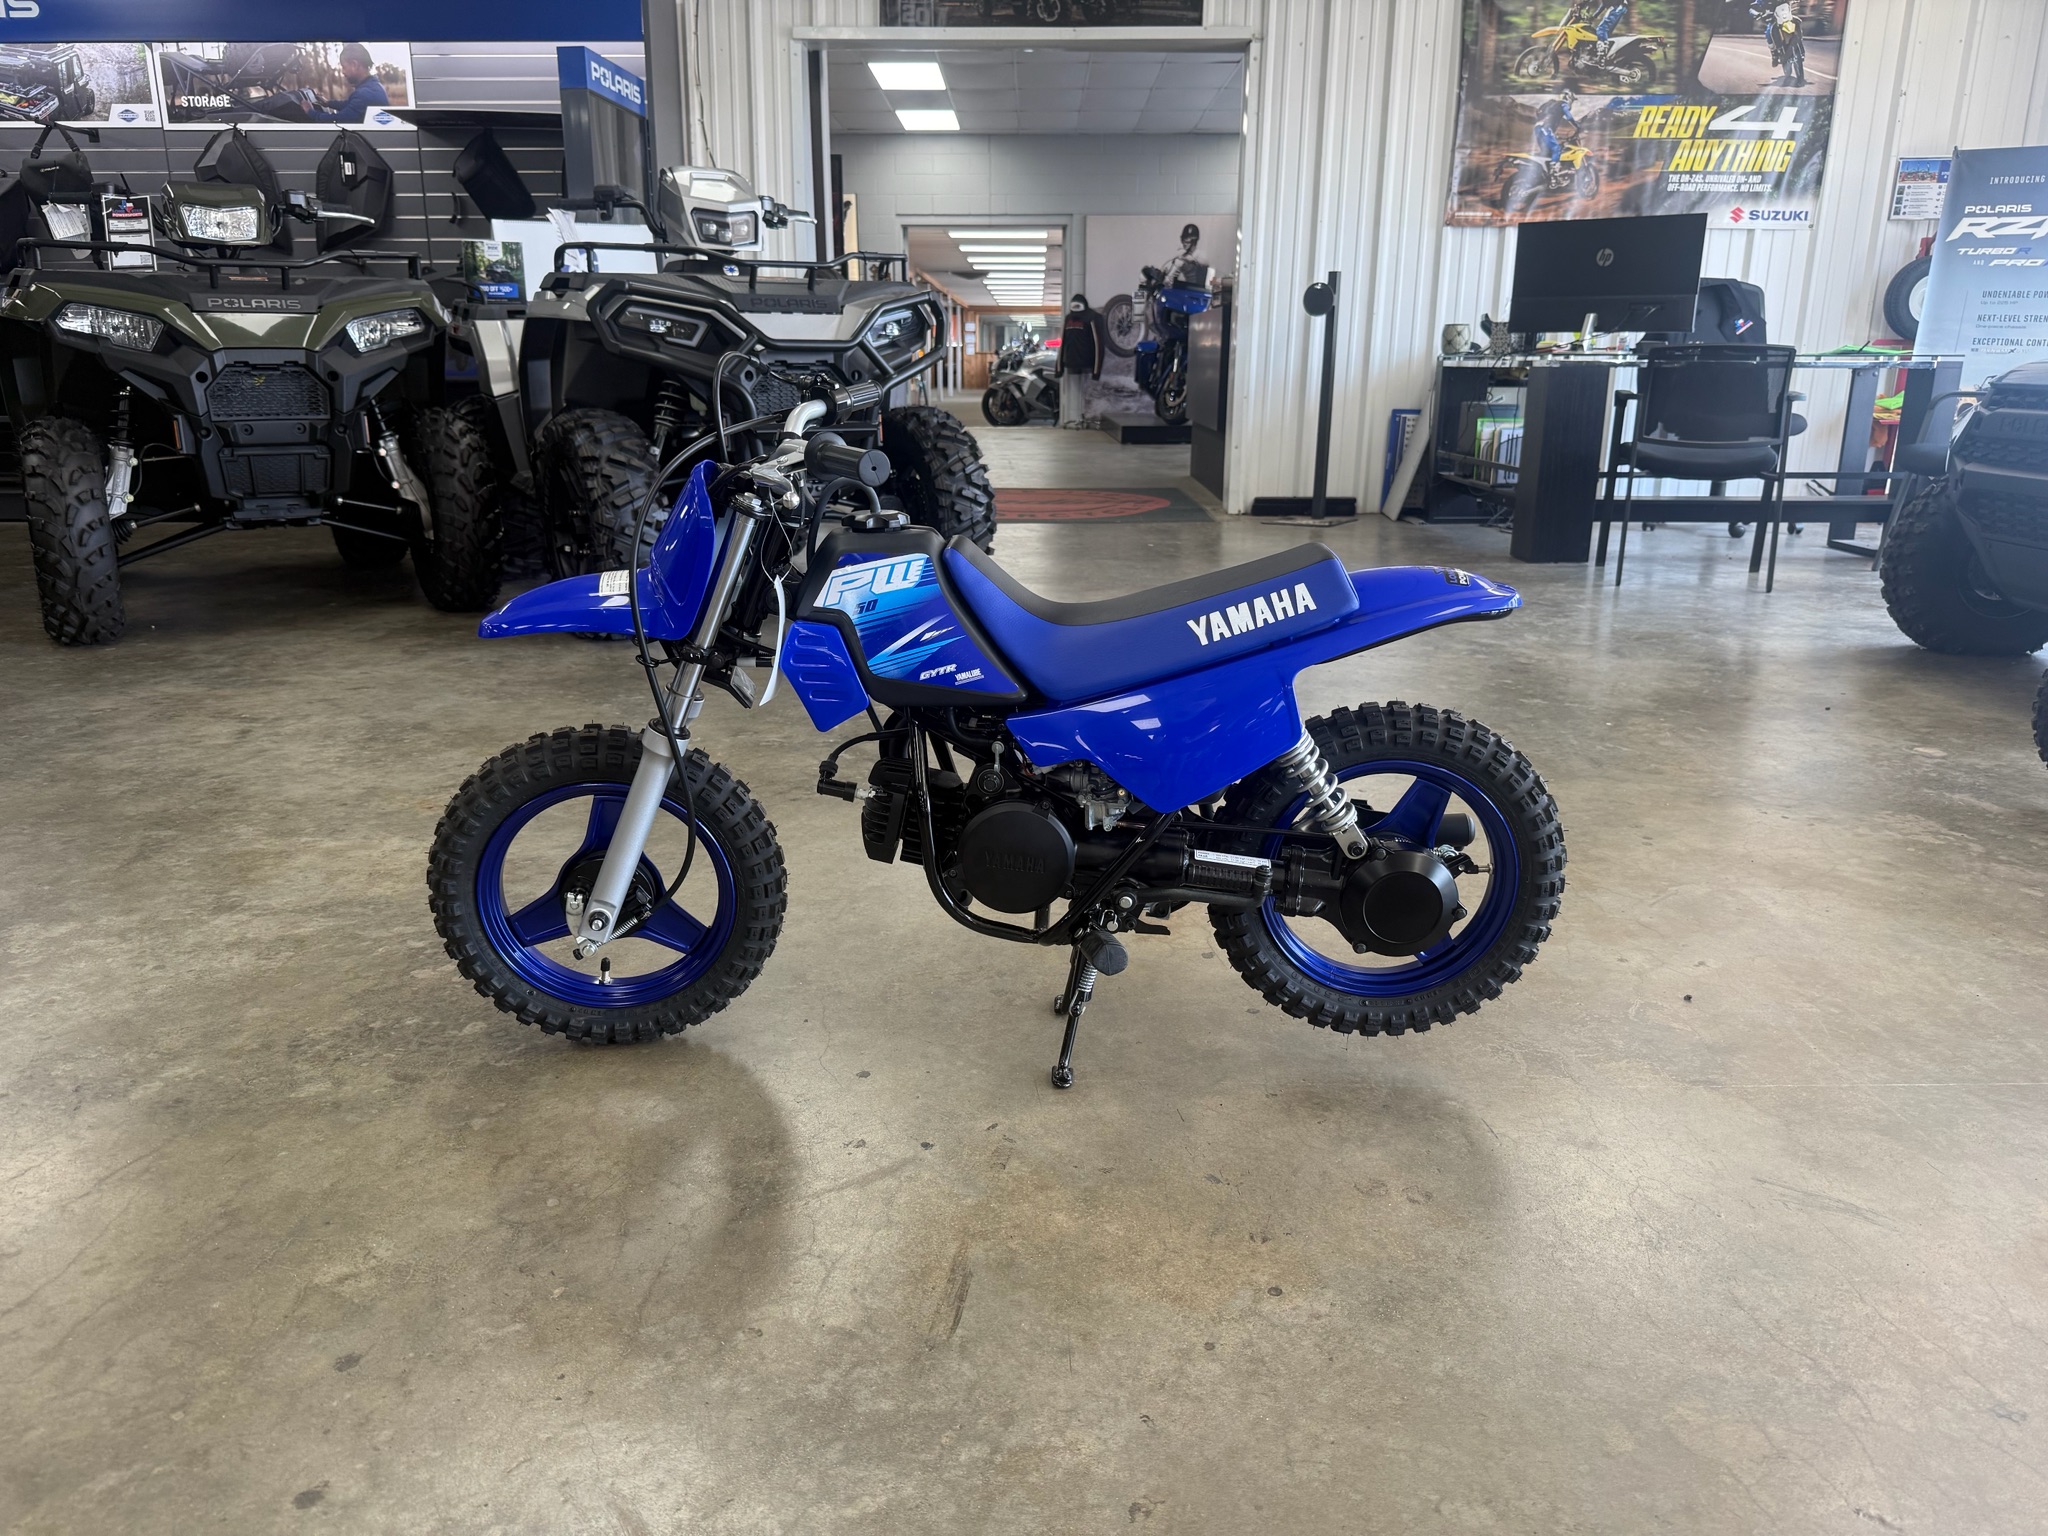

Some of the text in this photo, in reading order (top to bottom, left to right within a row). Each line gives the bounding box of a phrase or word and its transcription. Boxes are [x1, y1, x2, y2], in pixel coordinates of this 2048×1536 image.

[590, 60, 642, 105] POLARIS
[181, 96, 231, 108] STORAGE
[1633, 105, 1804, 139] READY 4
[1667, 139, 1796, 172] ANYTHING
[1668, 174, 1681, 182] THE
[1705, 174, 1736, 183] UNRIVALED
[1748, 175, 1762, 183] AND
[1990, 175, 2046, 185] INTRODUCING
[1667, 183, 1773, 193] OFF-ROAD PERFORMANCE. NO LIMITS.
[1964, 204, 2032, 214] POLARIS
[1748, 209, 1809, 222] SUZUKI
[1982, 290, 2031, 299] UNDENIABLE
[207, 298, 302, 310] POLARIS
[750, 298, 828, 309] POLARIS
[1977, 314, 2021, 323] NEXT-LEVEL
[1972, 337, 2048, 347] EXCEPTIONAL CONT
[824, 558, 927, 607] PW
[854, 599, 878, 615] 50
[1186, 583, 1317, 646] YAMAHA
[919, 663, 957, 681] GYTR
[954, 668, 982, 681] YAMALUBE
[984, 848, 1045, 874] YAMAHA
